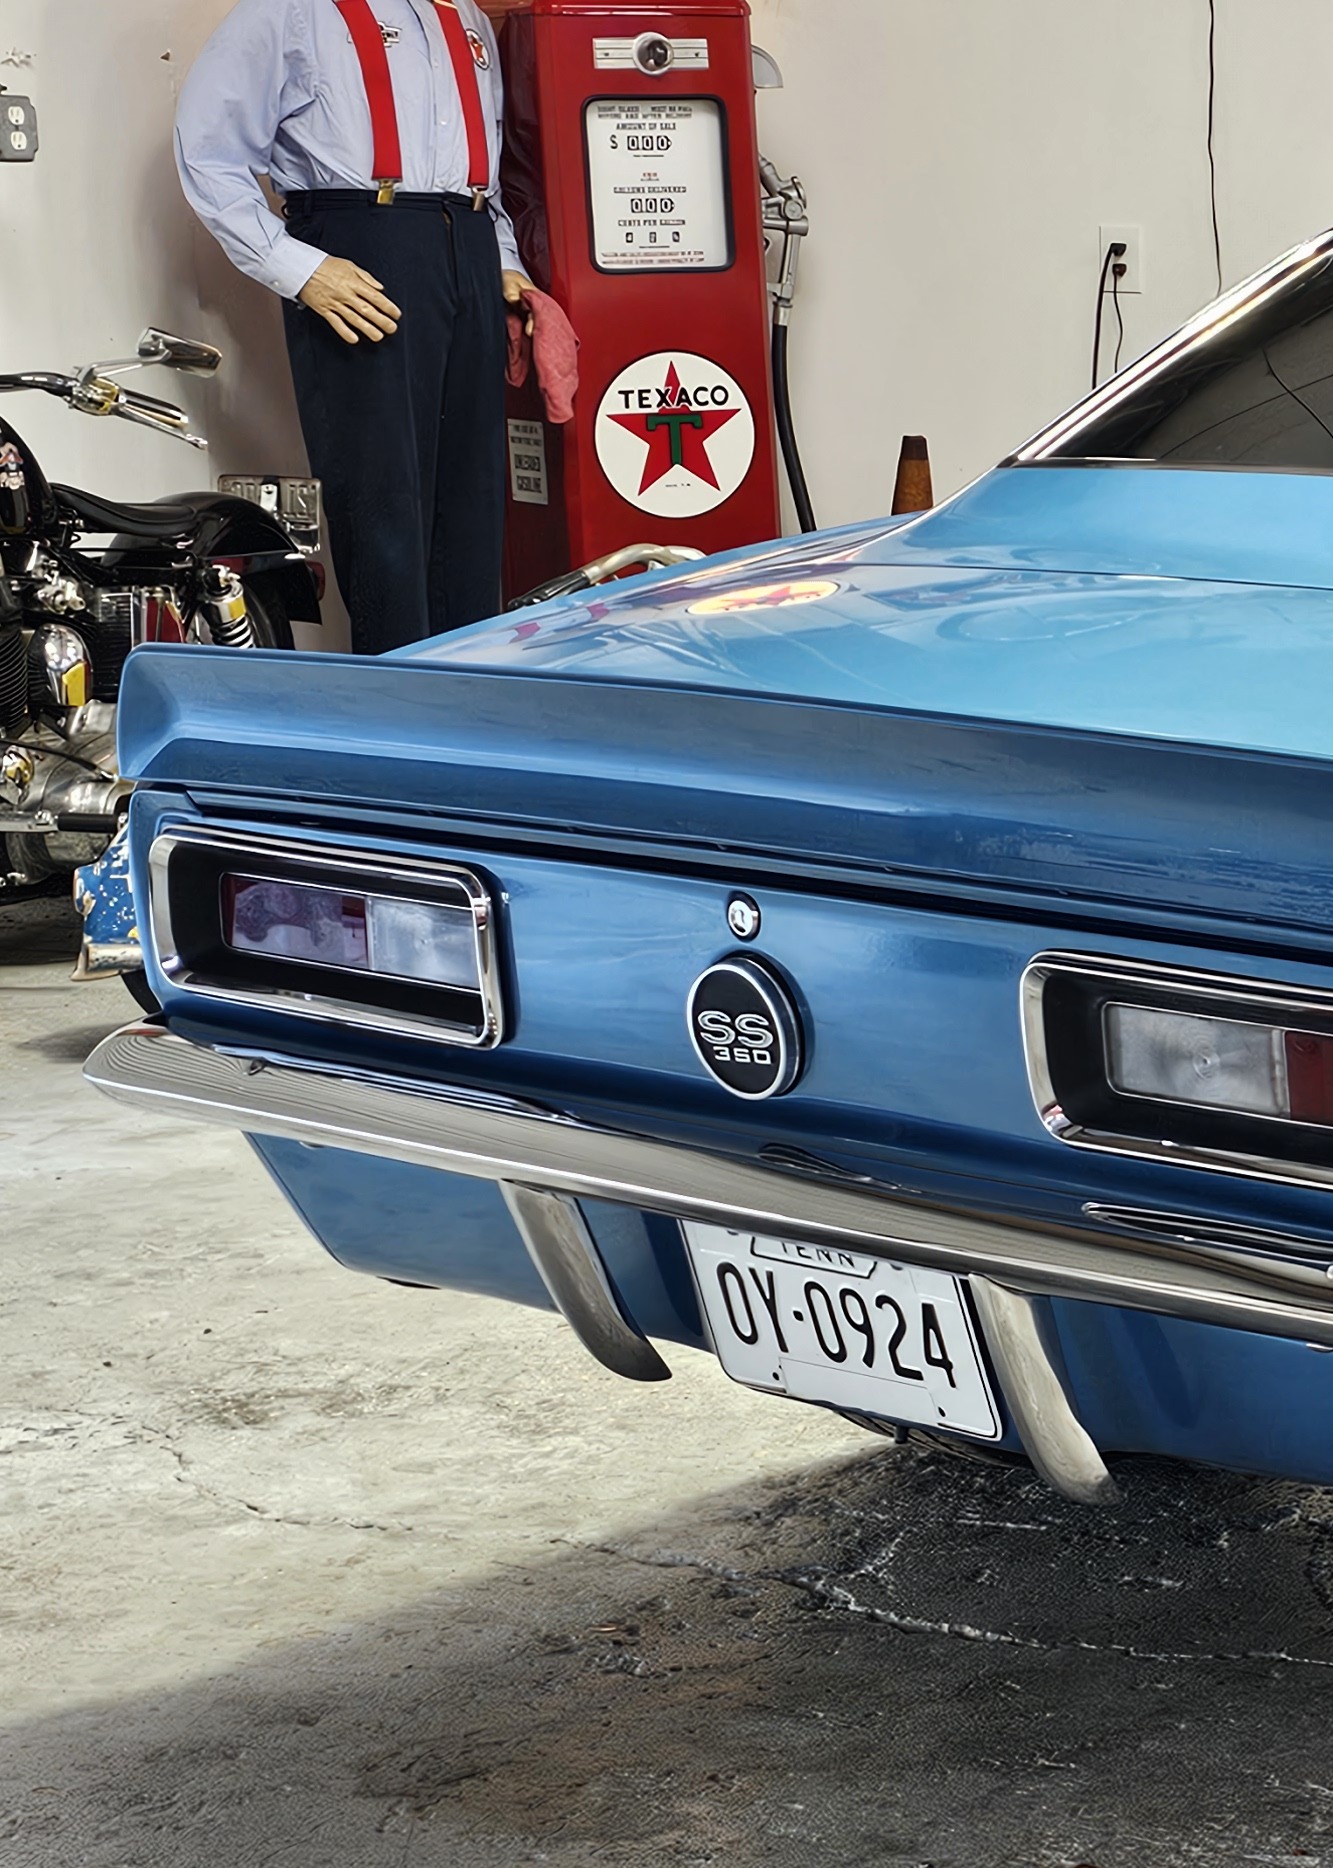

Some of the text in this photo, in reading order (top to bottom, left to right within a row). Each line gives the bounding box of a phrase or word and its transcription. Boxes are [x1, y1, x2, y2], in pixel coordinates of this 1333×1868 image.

[618, 385, 729, 409] TEXACO
[698, 1010, 774, 1048] SS
[713, 1046, 772, 1065] 350
